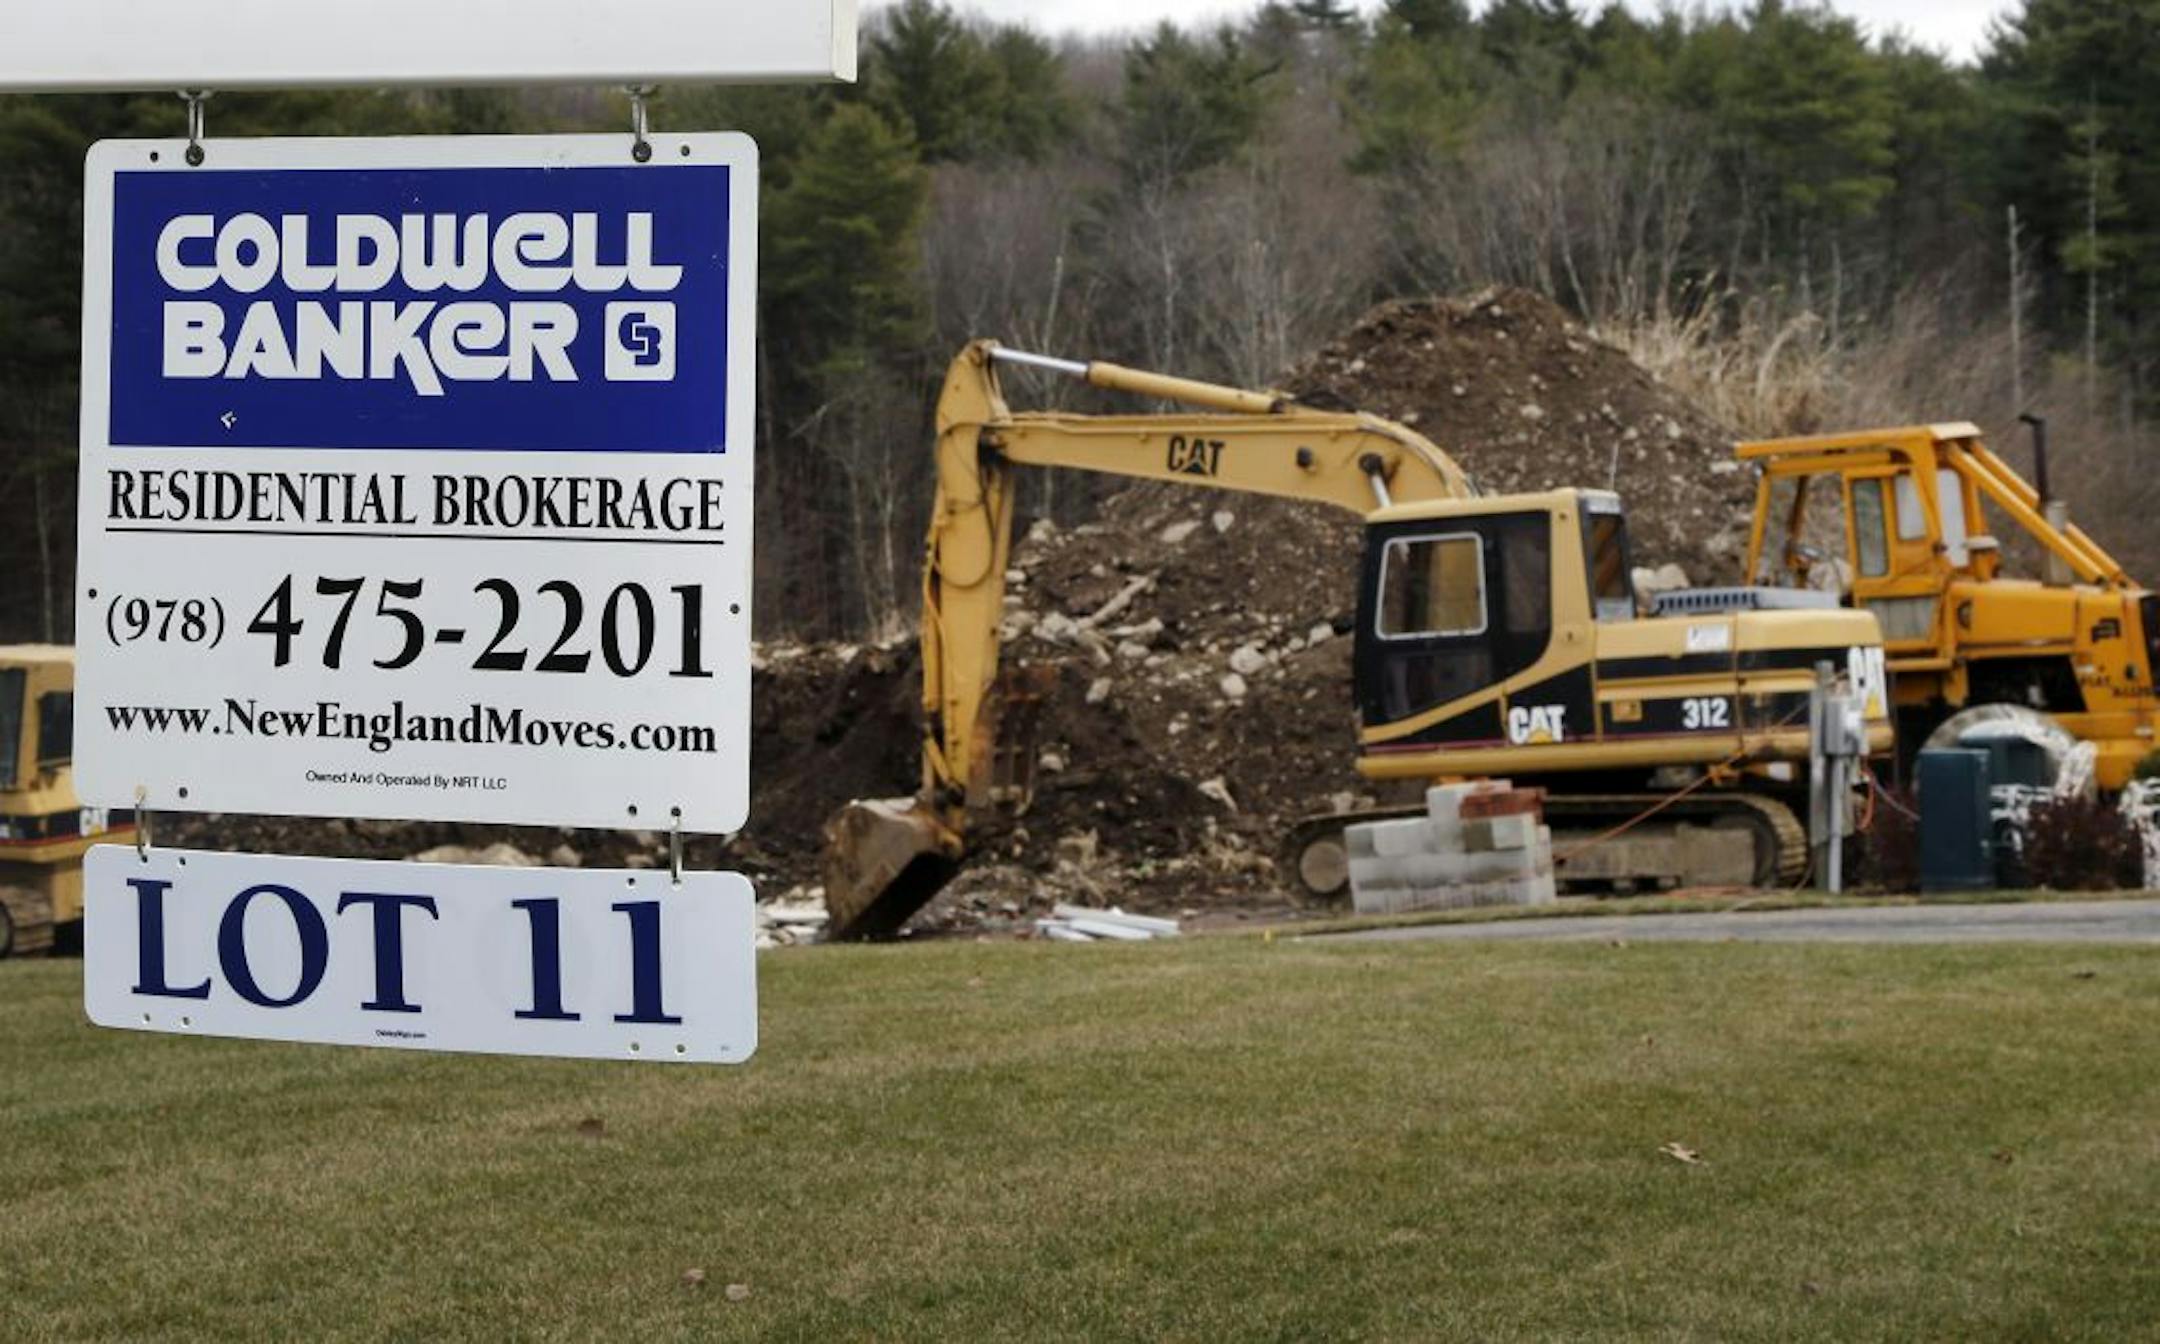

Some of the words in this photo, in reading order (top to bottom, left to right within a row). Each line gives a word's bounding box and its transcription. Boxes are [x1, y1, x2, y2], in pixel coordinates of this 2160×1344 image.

[1167, 434, 1225, 476] CAT
[107, 469, 418, 525] RESIDENTIAL
[432, 474, 724, 532] BROKERAGE
[106, 594, 225, 649] (978)
[246, 573, 714, 678] 475-2201
[104, 698, 717, 754] www.NewEnglandMoves.com
[1508, 705, 1566, 744] CAT
[1682, 697, 1729, 729] 312
[305, 769, 348, 784] Owned
[350, 771, 374, 785] And
[376, 772, 431, 788] Operated
[434, 774, 450, 790] By
[452, 775, 480, 789] NRT
[482, 777, 507, 790] LLC
[126, 877, 440, 1014] LOT
[510, 897, 683, 1026] 11
